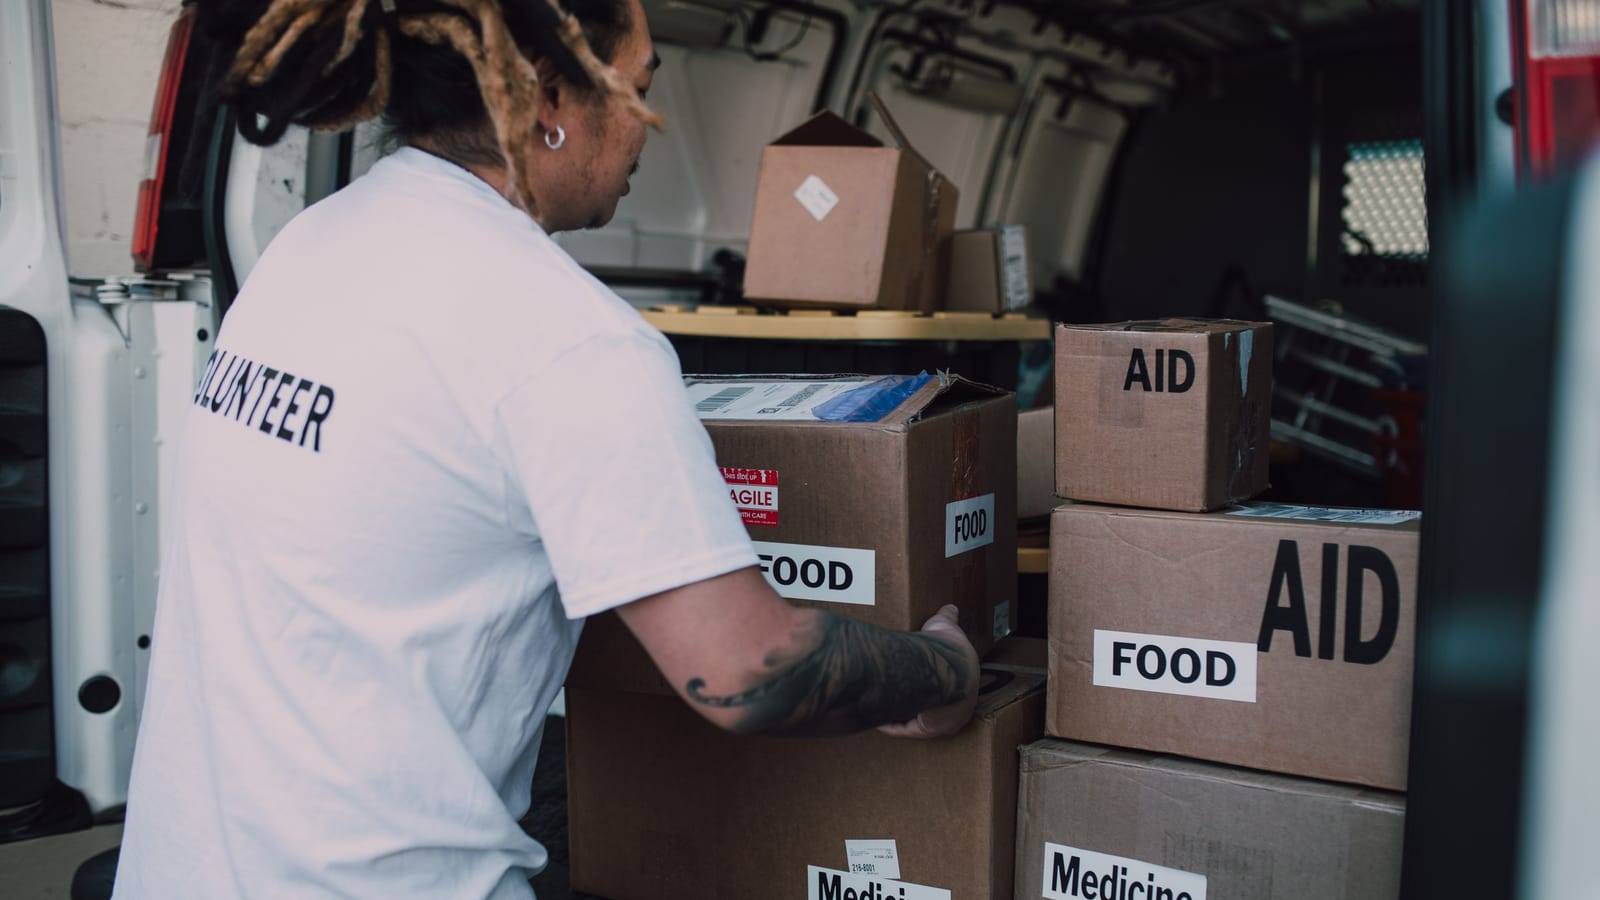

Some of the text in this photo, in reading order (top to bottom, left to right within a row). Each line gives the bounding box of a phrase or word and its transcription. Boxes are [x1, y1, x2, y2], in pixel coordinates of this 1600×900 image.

[1123, 348, 1196, 393] AID
[194, 349, 334, 452] OLUNTEER
[730, 489, 772, 506] AGILE
[955, 508, 987, 544] FOOD
[1257, 539, 1400, 665] AID
[1112, 641, 1236, 687] FOOD
[1051, 851, 1193, 900] Medici
